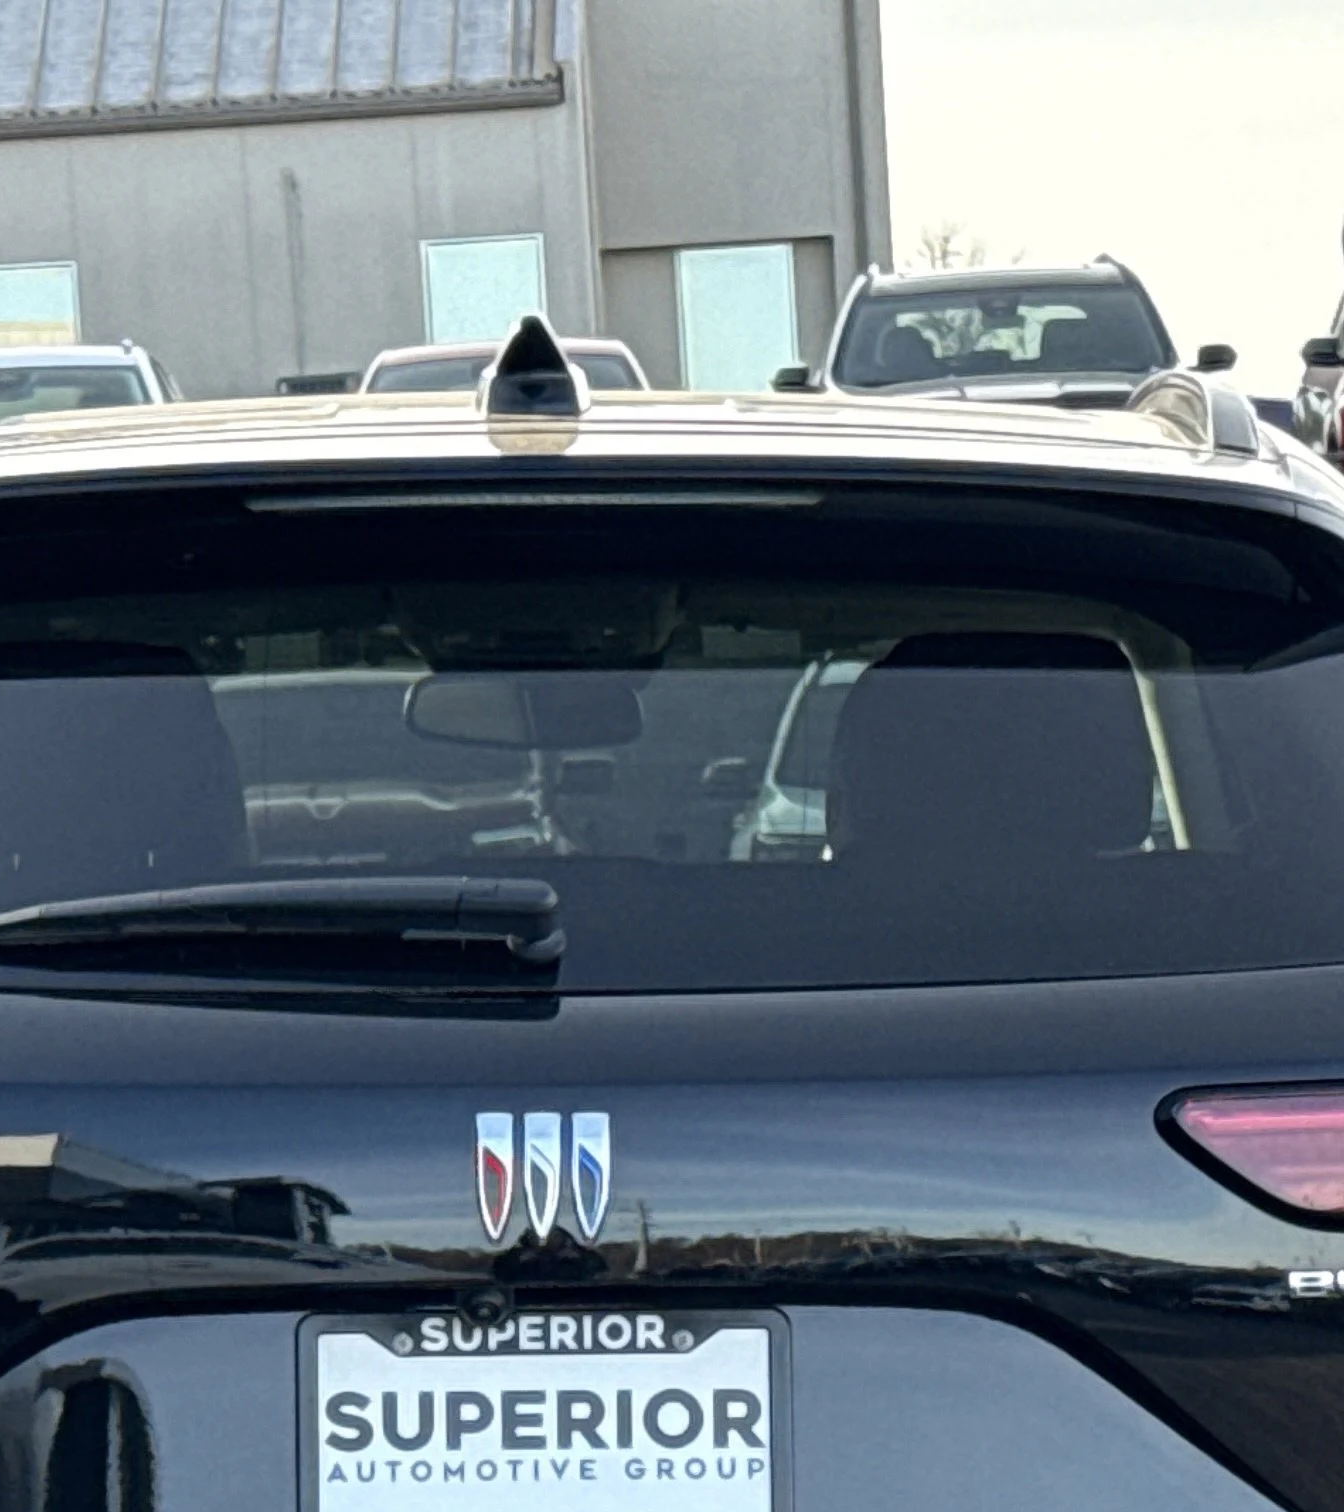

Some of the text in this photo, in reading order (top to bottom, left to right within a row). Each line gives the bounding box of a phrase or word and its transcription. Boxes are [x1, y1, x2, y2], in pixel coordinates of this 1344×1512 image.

[420, 1314, 665, 1352] SUPERIOR
[324, 1388, 766, 1452] SUPERIOR
[326, 1457, 765, 1484] AUTOMOTIVE GROUP
